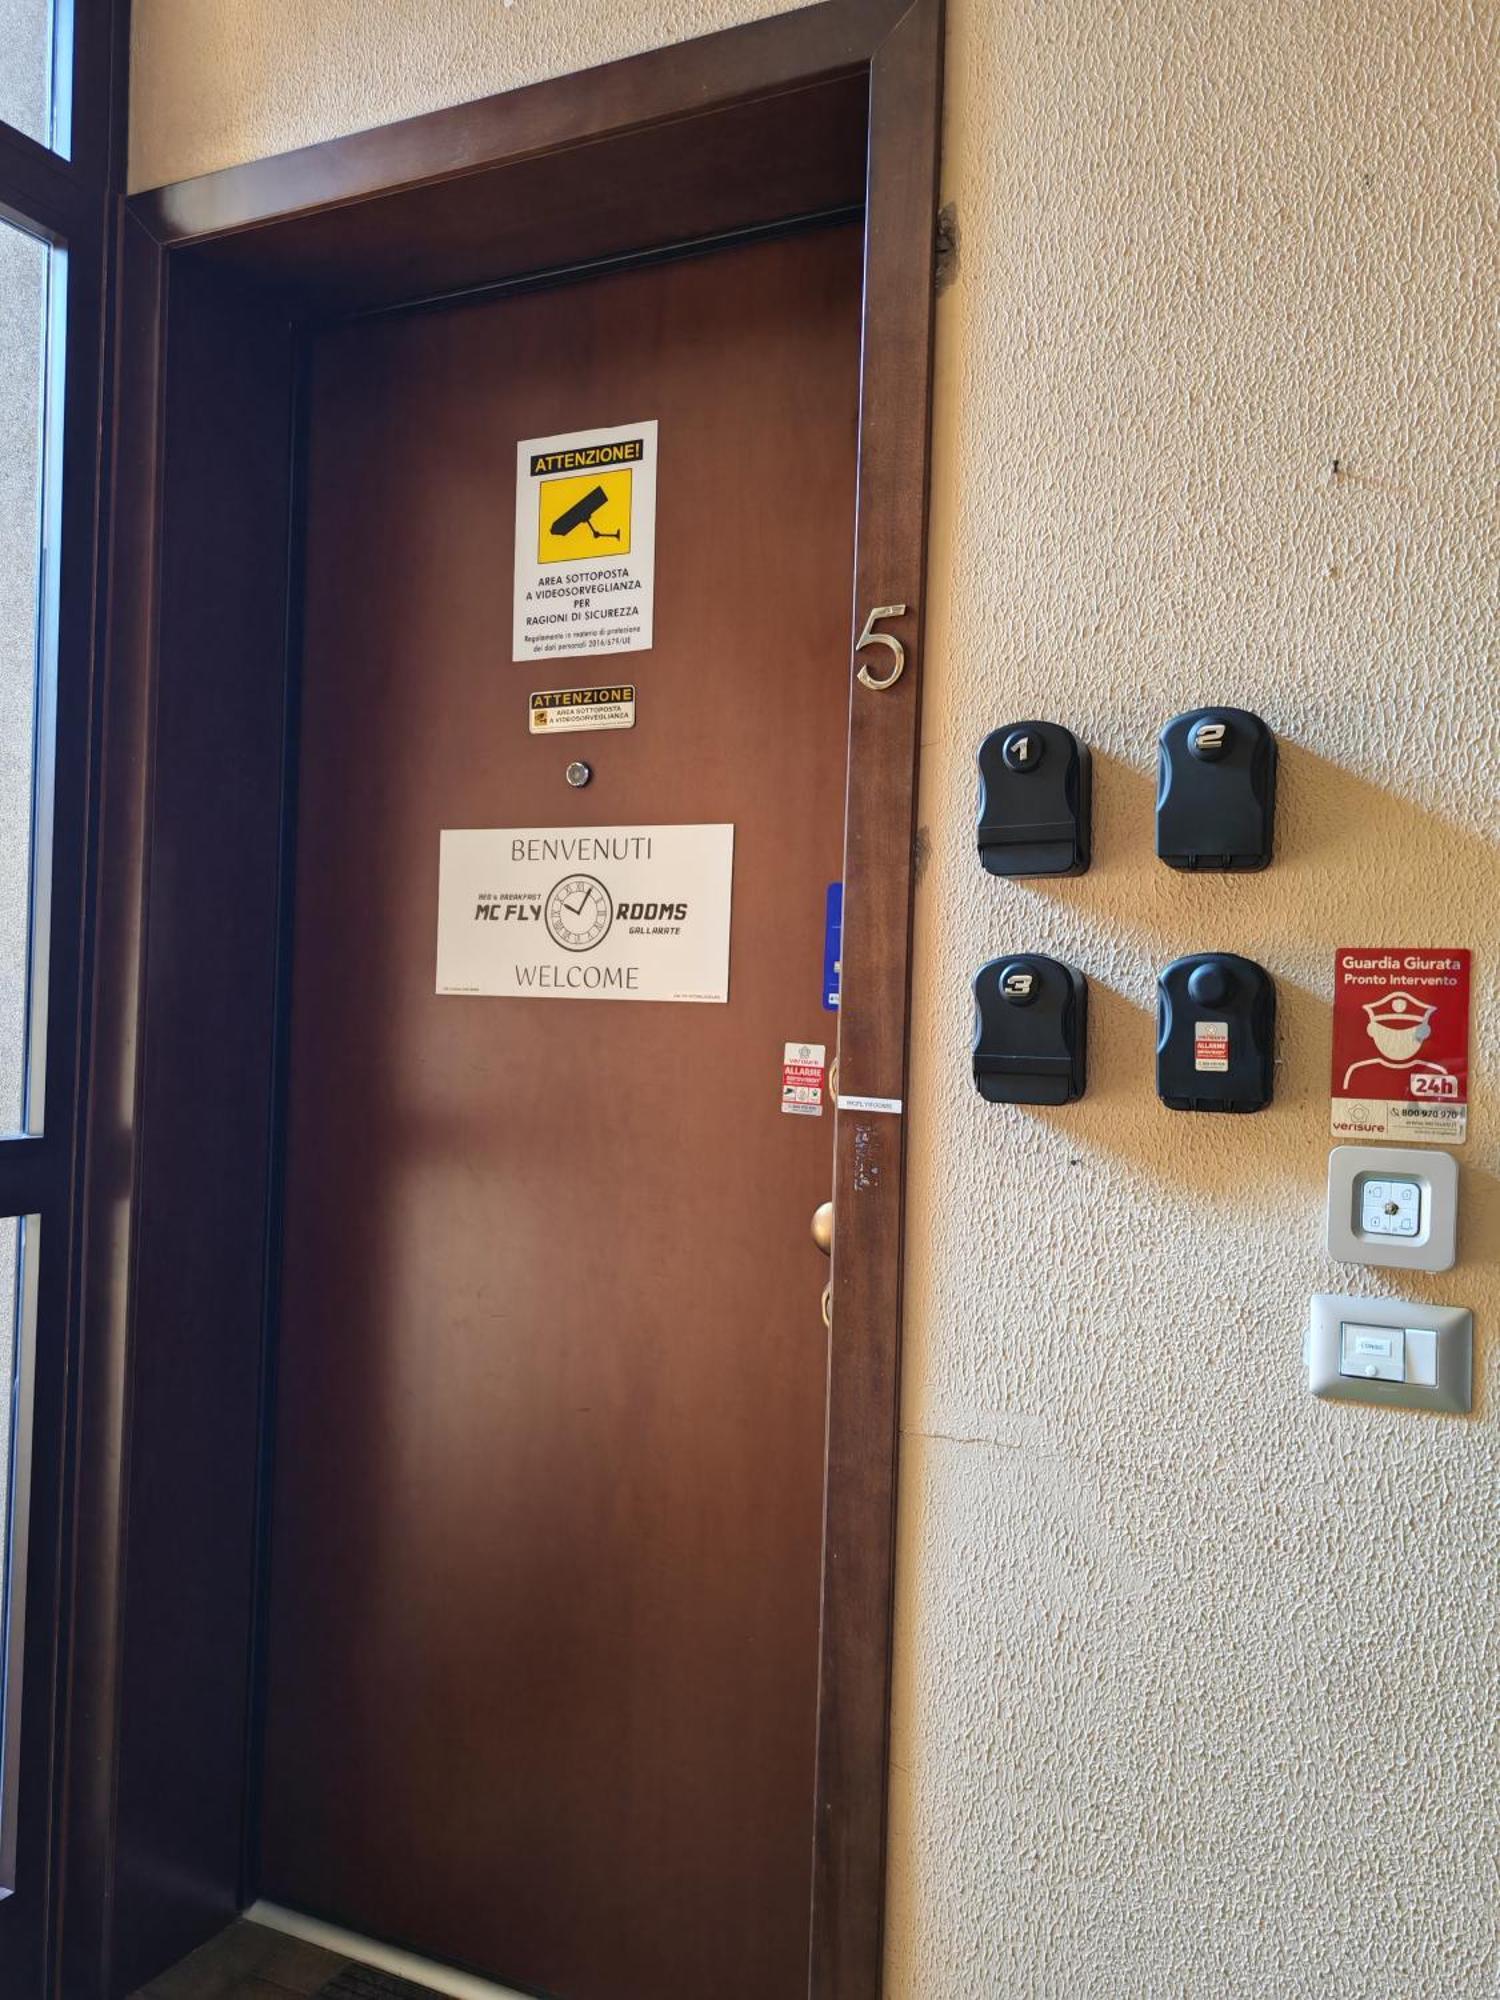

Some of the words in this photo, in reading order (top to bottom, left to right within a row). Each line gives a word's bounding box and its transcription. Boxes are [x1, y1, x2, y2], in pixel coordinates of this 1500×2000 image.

[534, 443, 641, 473] ATTENZIONE!
[538, 576, 563, 587] AREA
[565, 568, 630, 584] SOTTOPOSTA
[526, 591, 533, 600] A
[536, 579, 642, 600] VIDEOSORVEGLIANZA
[574, 599, 590, 608] PER
[526, 613, 568, 626] RAGIONI
[571, 612, 581, 621] DI
[585, 606, 639, 620] SICUREZZA
[855, 604, 906, 691] 5
[534, 688, 632, 707] ATTENZIONE
[555, 713, 629, 723] VIDEOSORVEGLIANZA
[576, 705, 622, 715] SOTTOPOSTA
[1195, 723, 1226, 750] 2
[1010, 737, 1029, 762] 1
[511, 837, 652, 862] BENVENUTI
[474, 904, 501, 921] MC
[504, 904, 542, 921] FLY
[616, 903, 688, 920] ROOMS
[629, 926, 681, 935] GALLARATE
[1342, 956, 1400, 970] Guardia
[1404, 956, 1461, 971] Giurata
[515, 964, 640, 990] WELCOME
[1005, 974, 1033, 997] 3
[1344, 974, 1387, 985] Pronto
[1390, 974, 1458, 986] Intervento
[785, 1066, 822, 1077] ALLARME
[1416, 1078, 1453, 1095] 24h
[1402, 1109, 1420, 1117] 800
[1421, 1109, 1438, 1118] 970
[1440, 1110, 1457, 1119] 970
[1333, 1122, 1385, 1133] verisure
